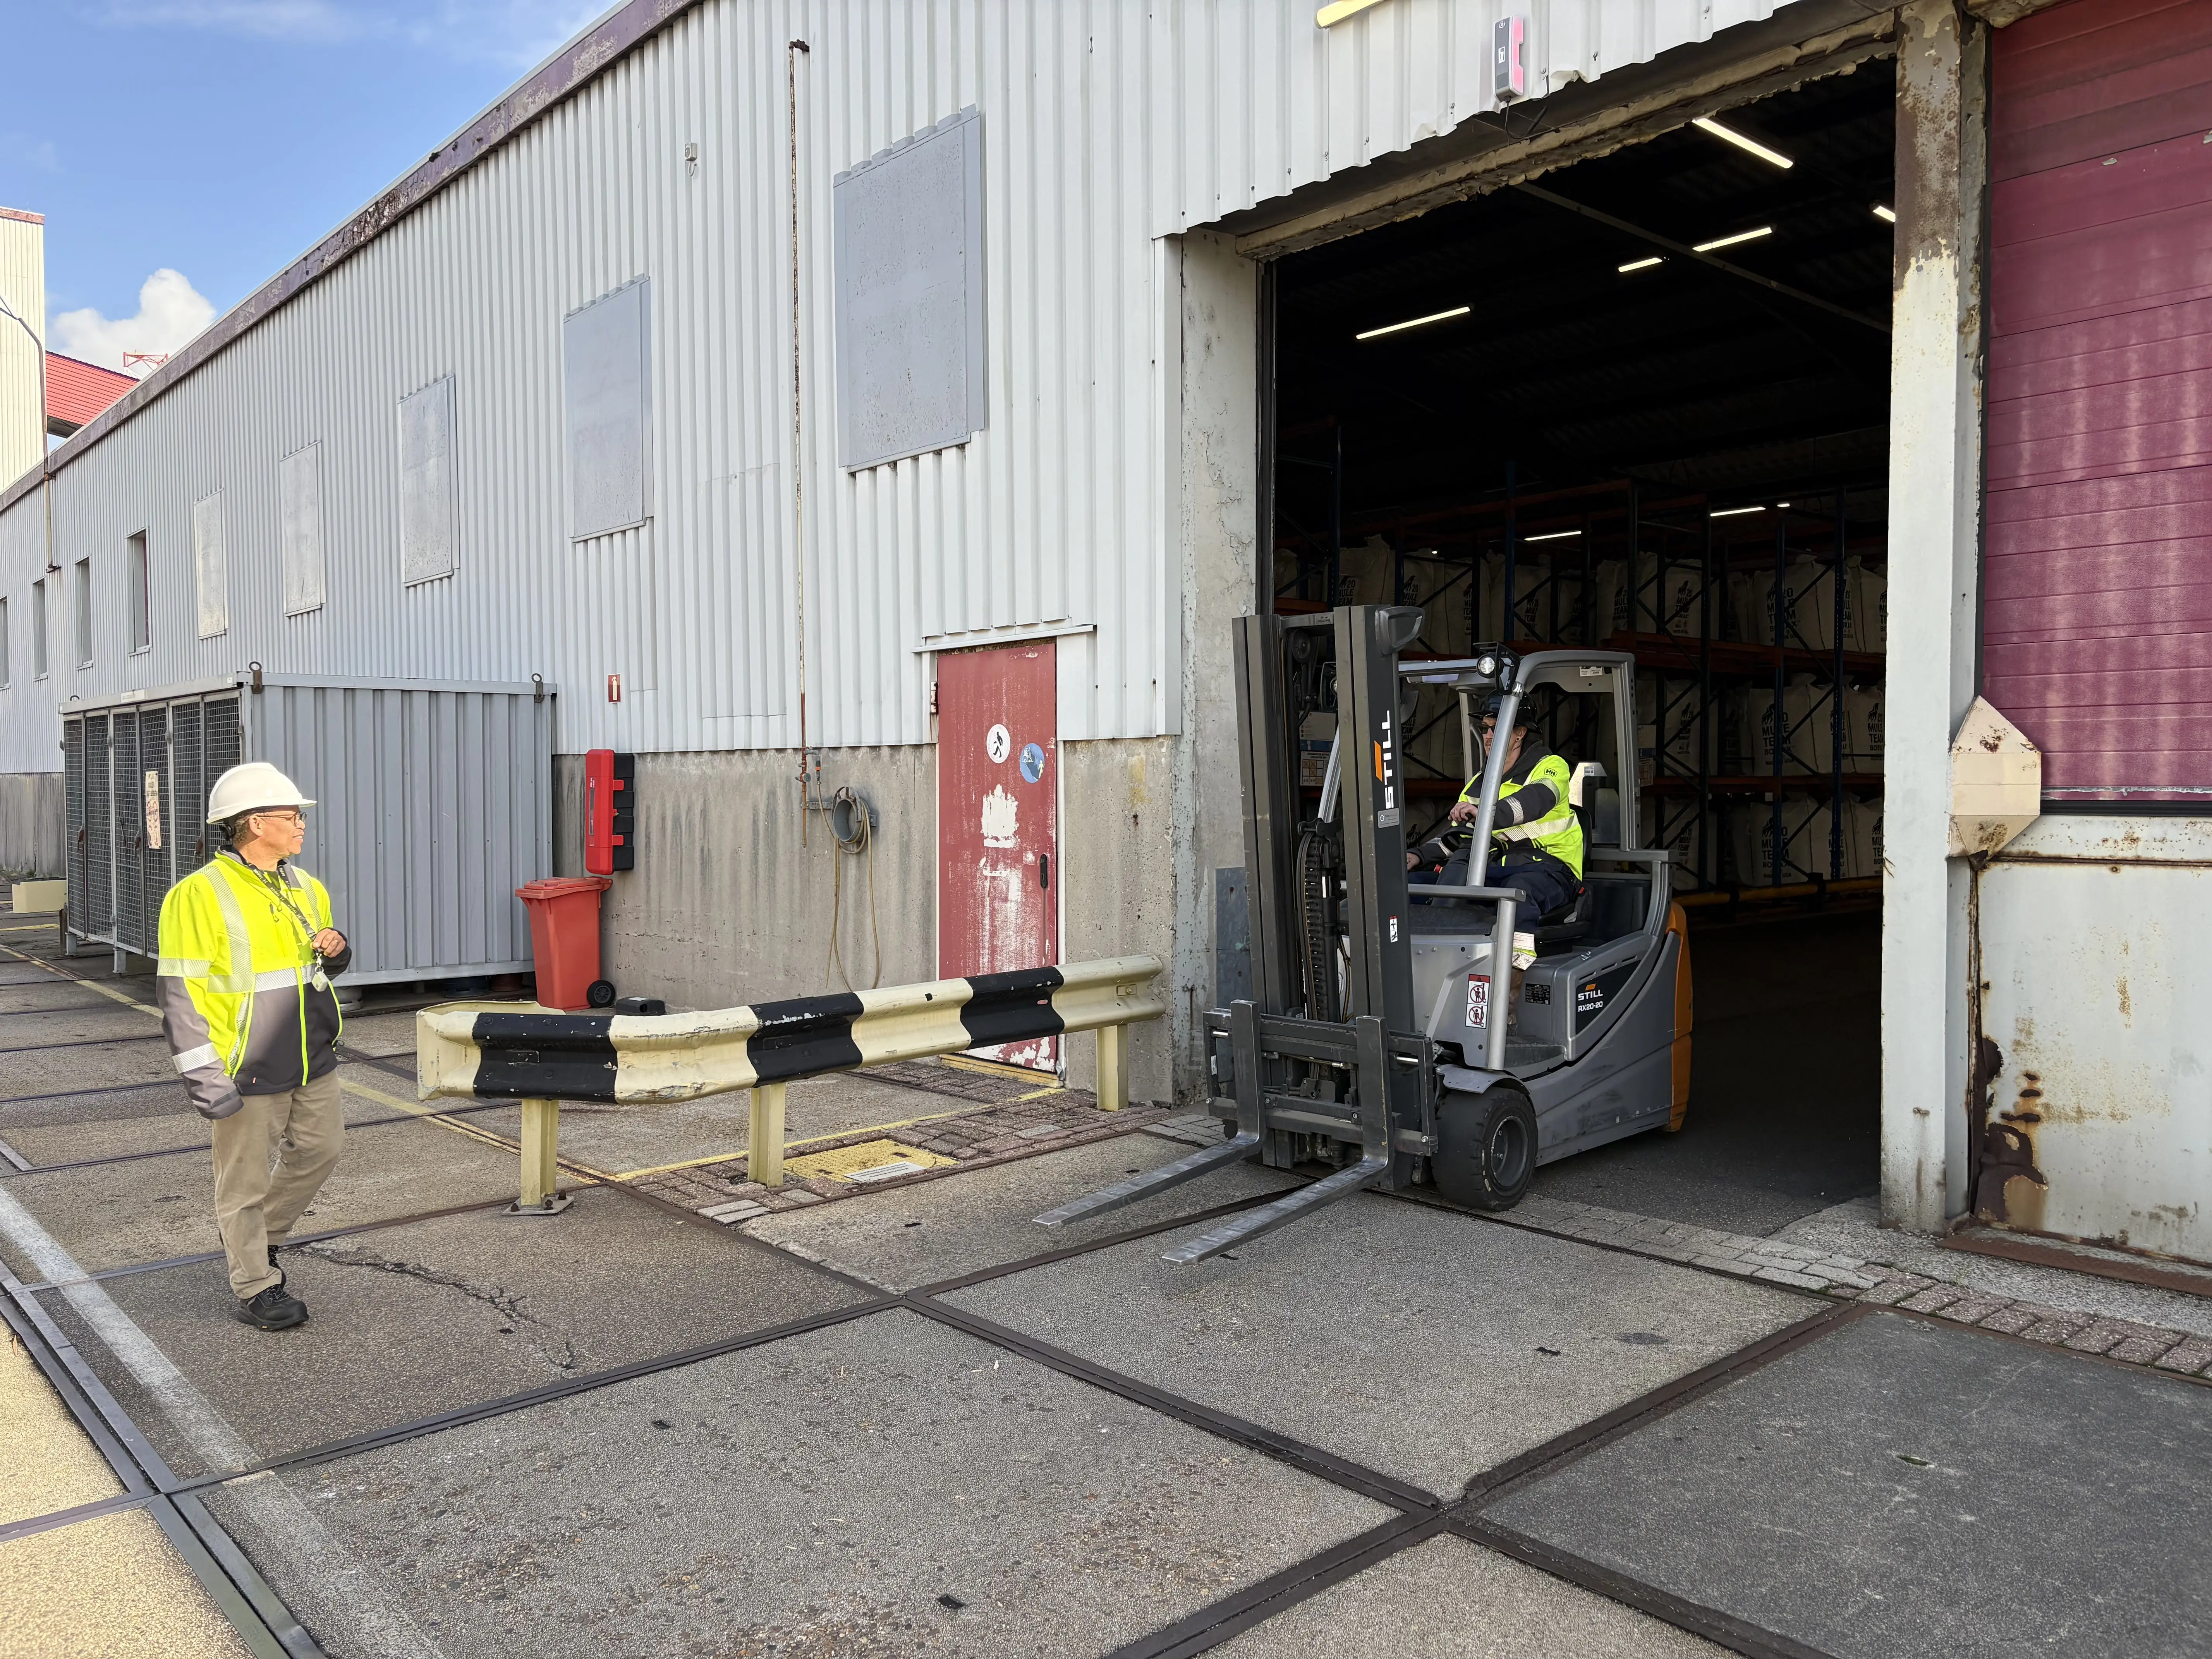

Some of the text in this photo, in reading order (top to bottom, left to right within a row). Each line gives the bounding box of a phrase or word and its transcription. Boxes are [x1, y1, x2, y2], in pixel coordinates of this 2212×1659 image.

[1412, 584, 1419, 592] 20
[1340, 598, 1353, 606] EAM
[1762, 723, 1790, 736] MUE
[1382, 710, 1394, 809] STILL
[1578, 989, 1603, 1001] STILL
[1578, 1001, 1603, 1012] RX20-20
